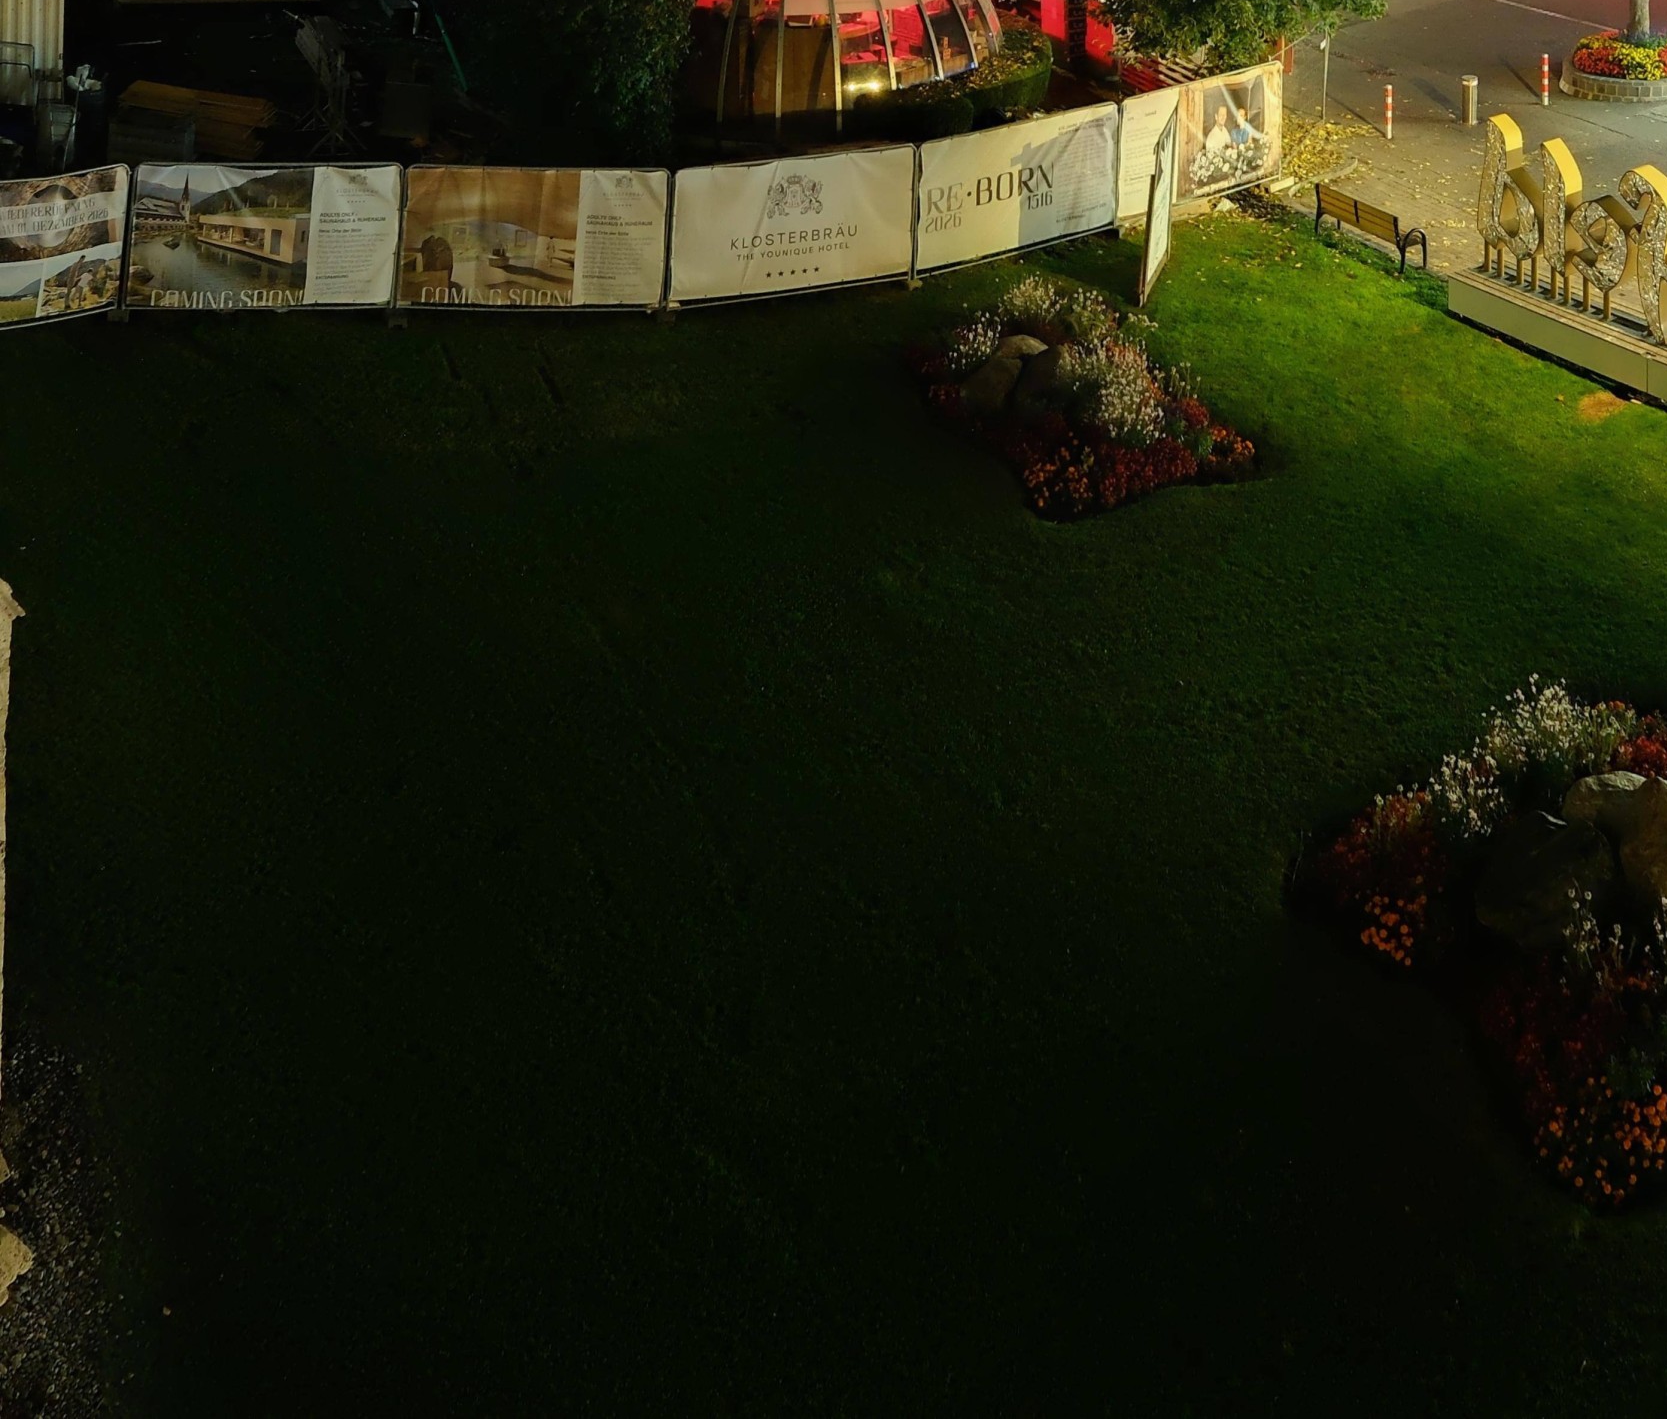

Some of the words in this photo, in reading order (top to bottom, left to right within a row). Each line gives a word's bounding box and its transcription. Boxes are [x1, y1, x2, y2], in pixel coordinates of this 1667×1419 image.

[1027, 191, 1053, 210] 1516
[925, 212, 962, 234] 2026
[731, 223, 858, 250] KLOSTERBRÄU
[761, 246, 814, 259] YOUNIQUE
[819, 242, 851, 253] HOTEL
[150, 289, 236, 308] COMING
[421, 286, 502, 304] COMING
